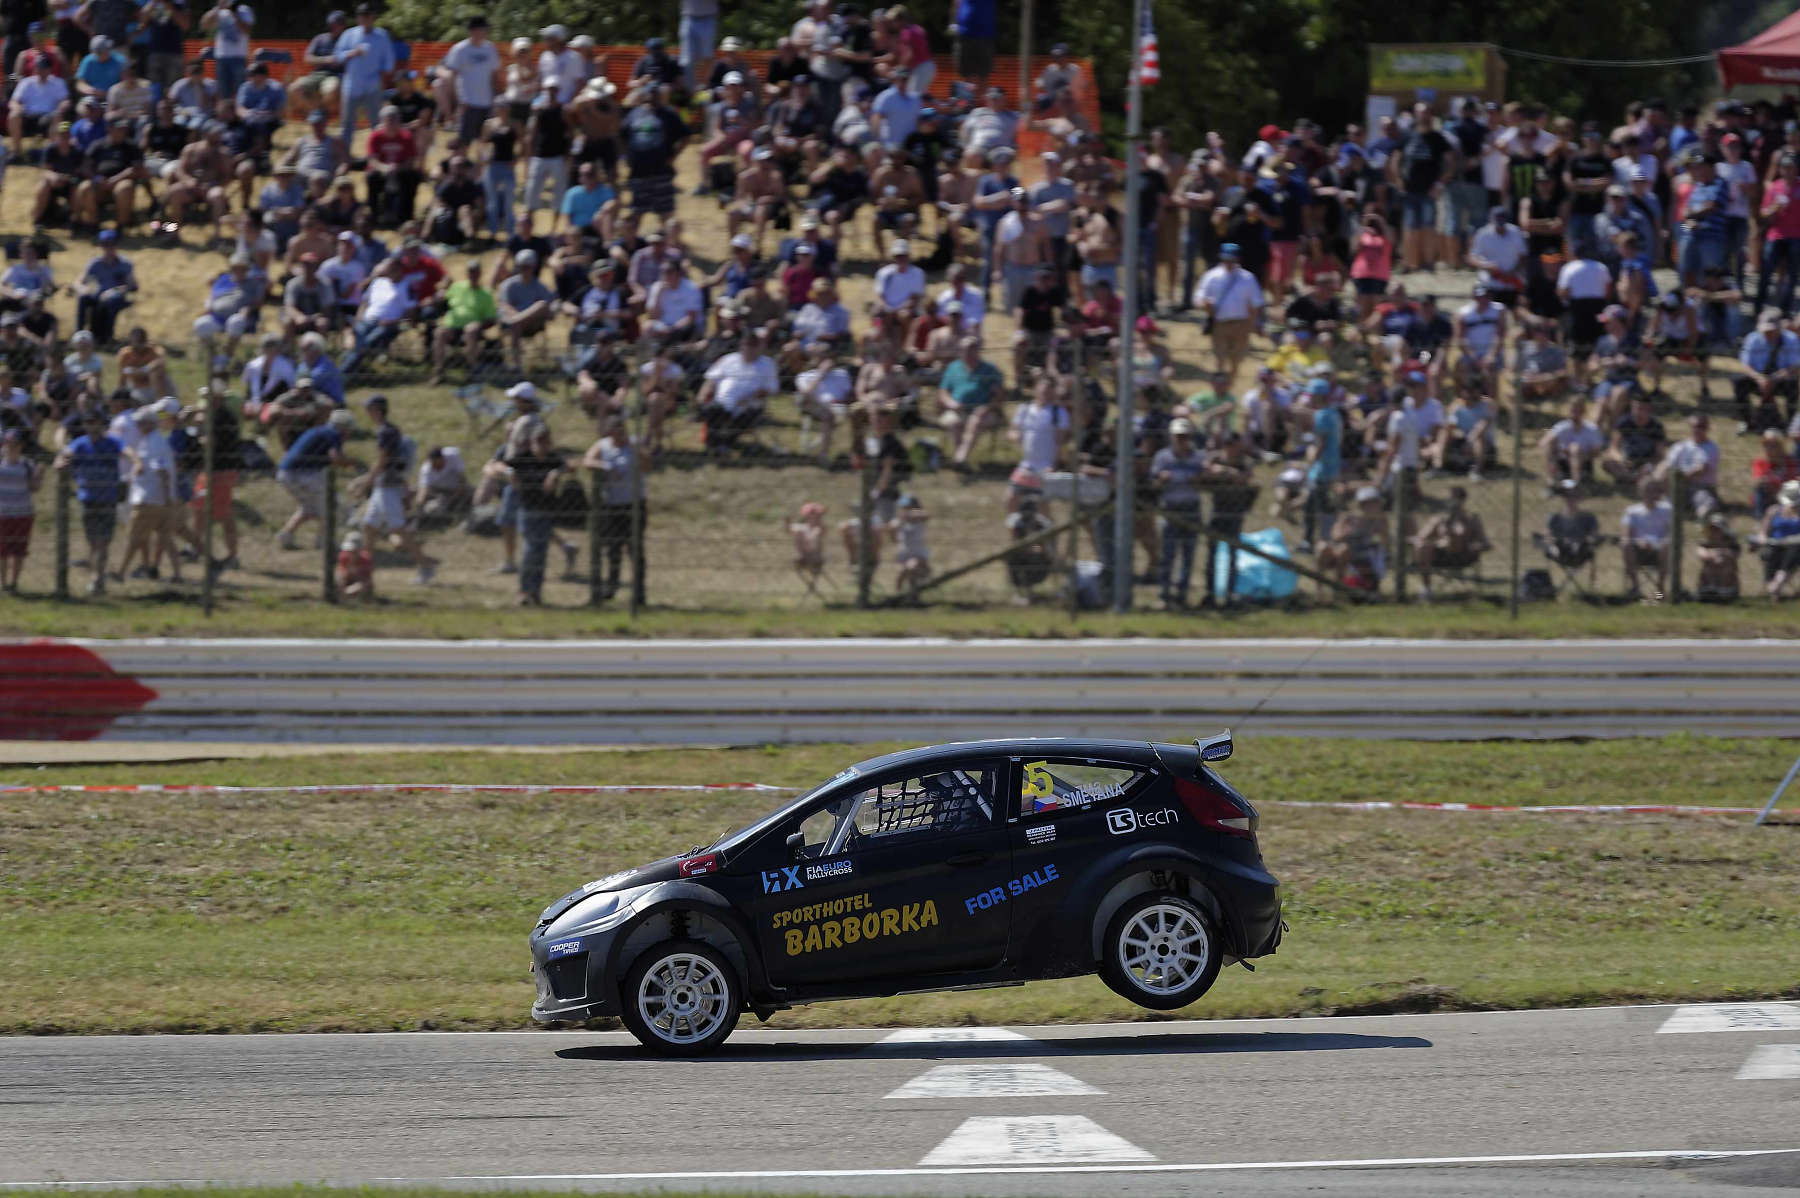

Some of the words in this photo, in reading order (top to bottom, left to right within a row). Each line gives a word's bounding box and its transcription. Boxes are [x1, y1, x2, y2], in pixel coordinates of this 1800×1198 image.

[1026, 760, 1054, 798] 5
[1136, 807, 1179, 828] tech
[807, 866, 853, 881] RALLYCROSS
[964, 886, 1007, 916] FOR
[1007, 863, 1060, 897] SALE
[772, 892, 873, 929] SPORTHOTEL
[784, 899, 939, 956] BARBORKA
[549, 941, 580, 953] COOPER
